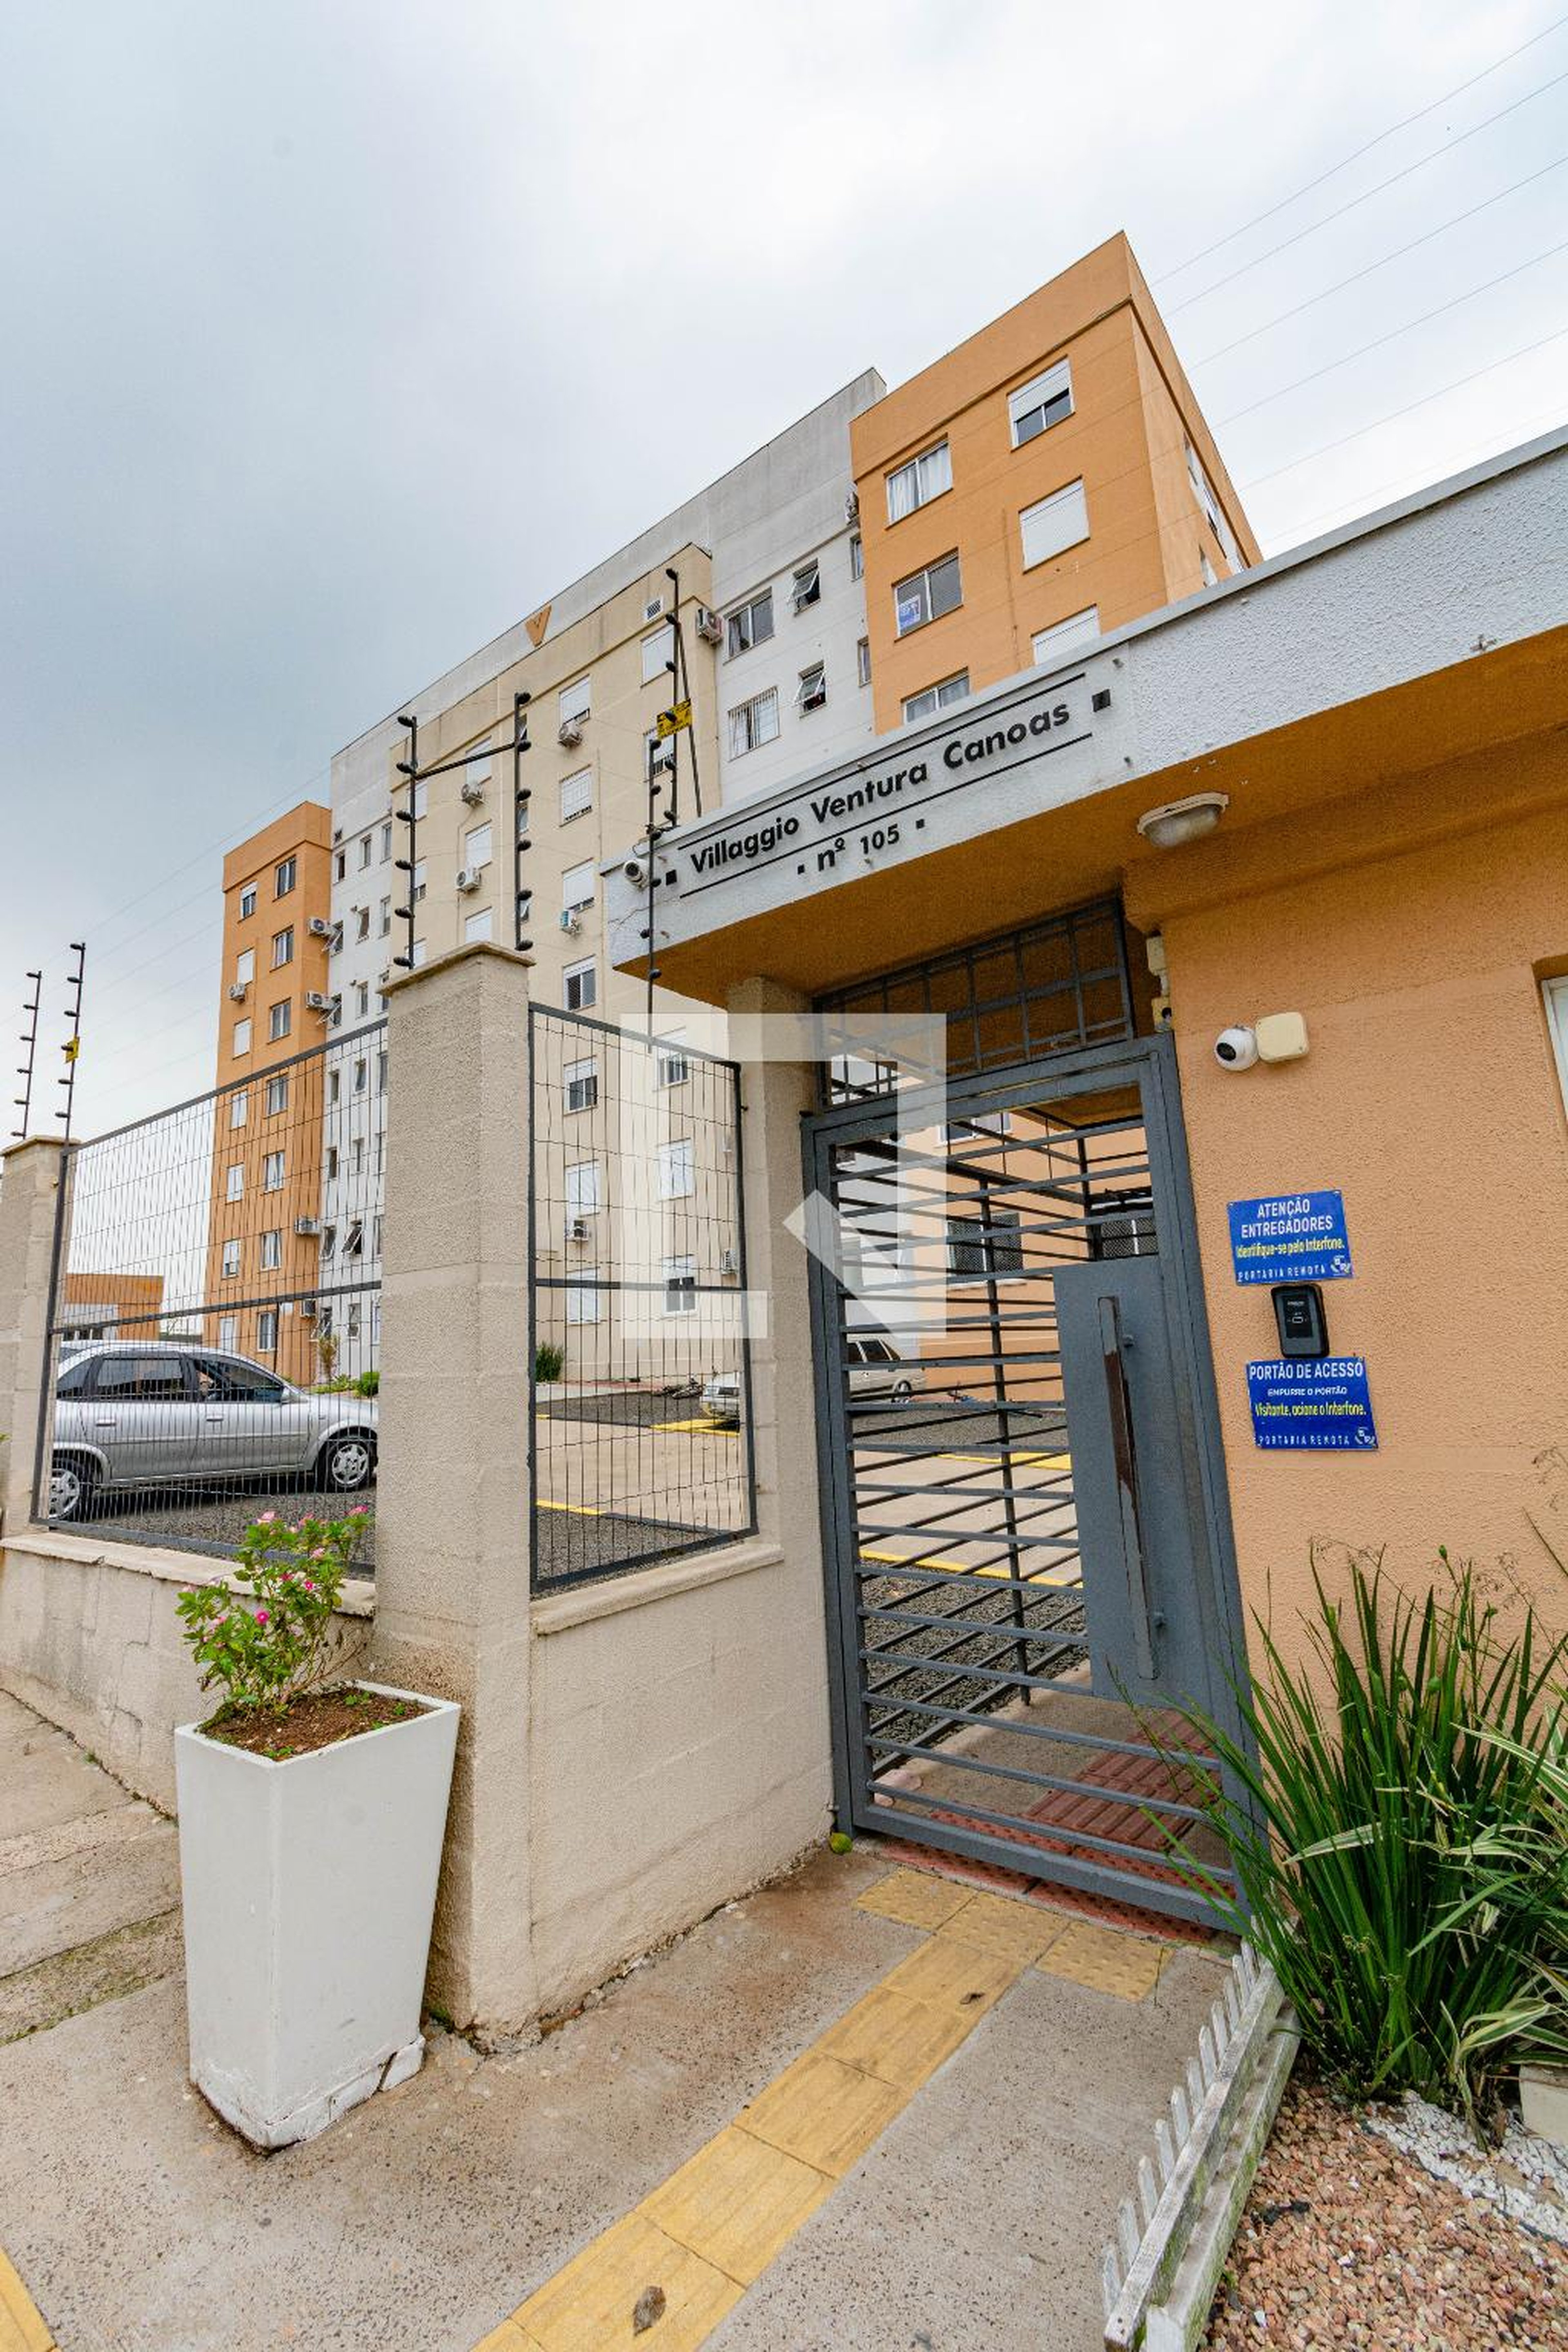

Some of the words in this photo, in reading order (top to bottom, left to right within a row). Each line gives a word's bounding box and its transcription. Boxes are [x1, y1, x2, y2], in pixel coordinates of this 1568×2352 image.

[690, 817, 799, 873] Villaggio
[810, 762, 927, 823] Ventura
[944, 704, 1069, 769] Canoas
[860, 824, 899, 854] 105
[1257, 1197, 1310, 1218] ATENÇÃO
[1241, 1215, 1333, 1238] ENTREGADORES
[1236, 1243, 1287, 1258] Identifique-se
[1287, 1239, 1305, 1256] pelo
[1306, 1236, 1345, 1252] Interfone.
[1238, 1267, 1284, 1282] PORTARIA
[1287, 1265, 1326, 1276] REMOTA
[1250, 1362, 1293, 1380] PORTÃO
[1296, 1364, 1312, 1379] DE
[1314, 1362, 1363, 1378] ACESSO
[1267, 1388, 1305, 1396] EMPURRE
[1315, 1385, 1347, 1395] PORTÃO
[1255, 1402, 1291, 1417] Visitante,
[1292, 1402, 1318, 1416] acione
[1319, 1406, 1325, 1415] o
[1326, 1401, 1366, 1415] Interfone.
[1259, 1435, 1306, 1446] PORTARIA
[1310, 1435, 1350, 1445] REMOTA
